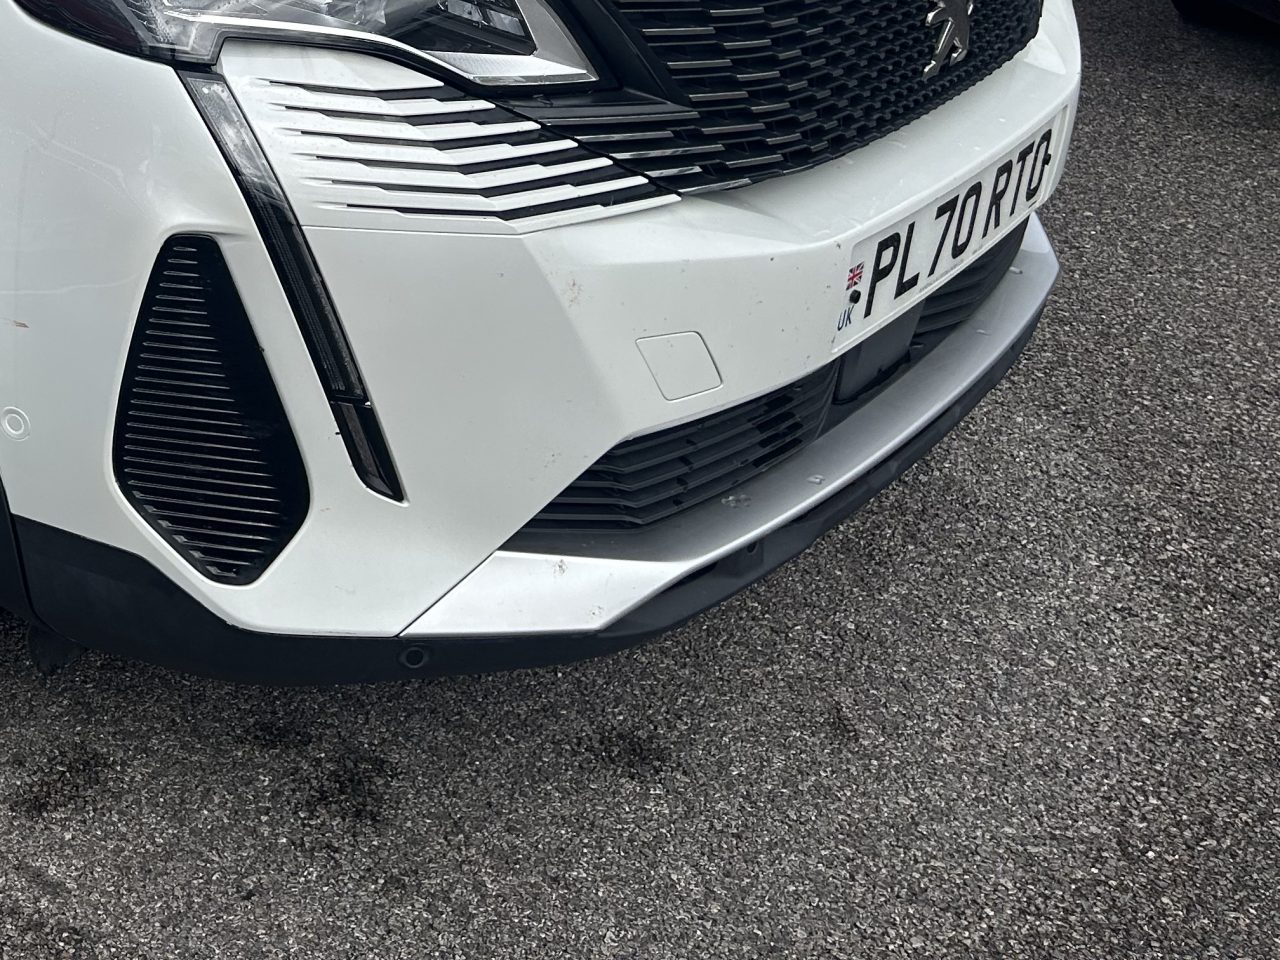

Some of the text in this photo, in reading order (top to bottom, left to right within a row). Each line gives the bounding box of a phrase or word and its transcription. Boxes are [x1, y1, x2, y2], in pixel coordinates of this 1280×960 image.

[863, 128, 1053, 319] PL70 RTO
[837, 305, 855, 332] UK
